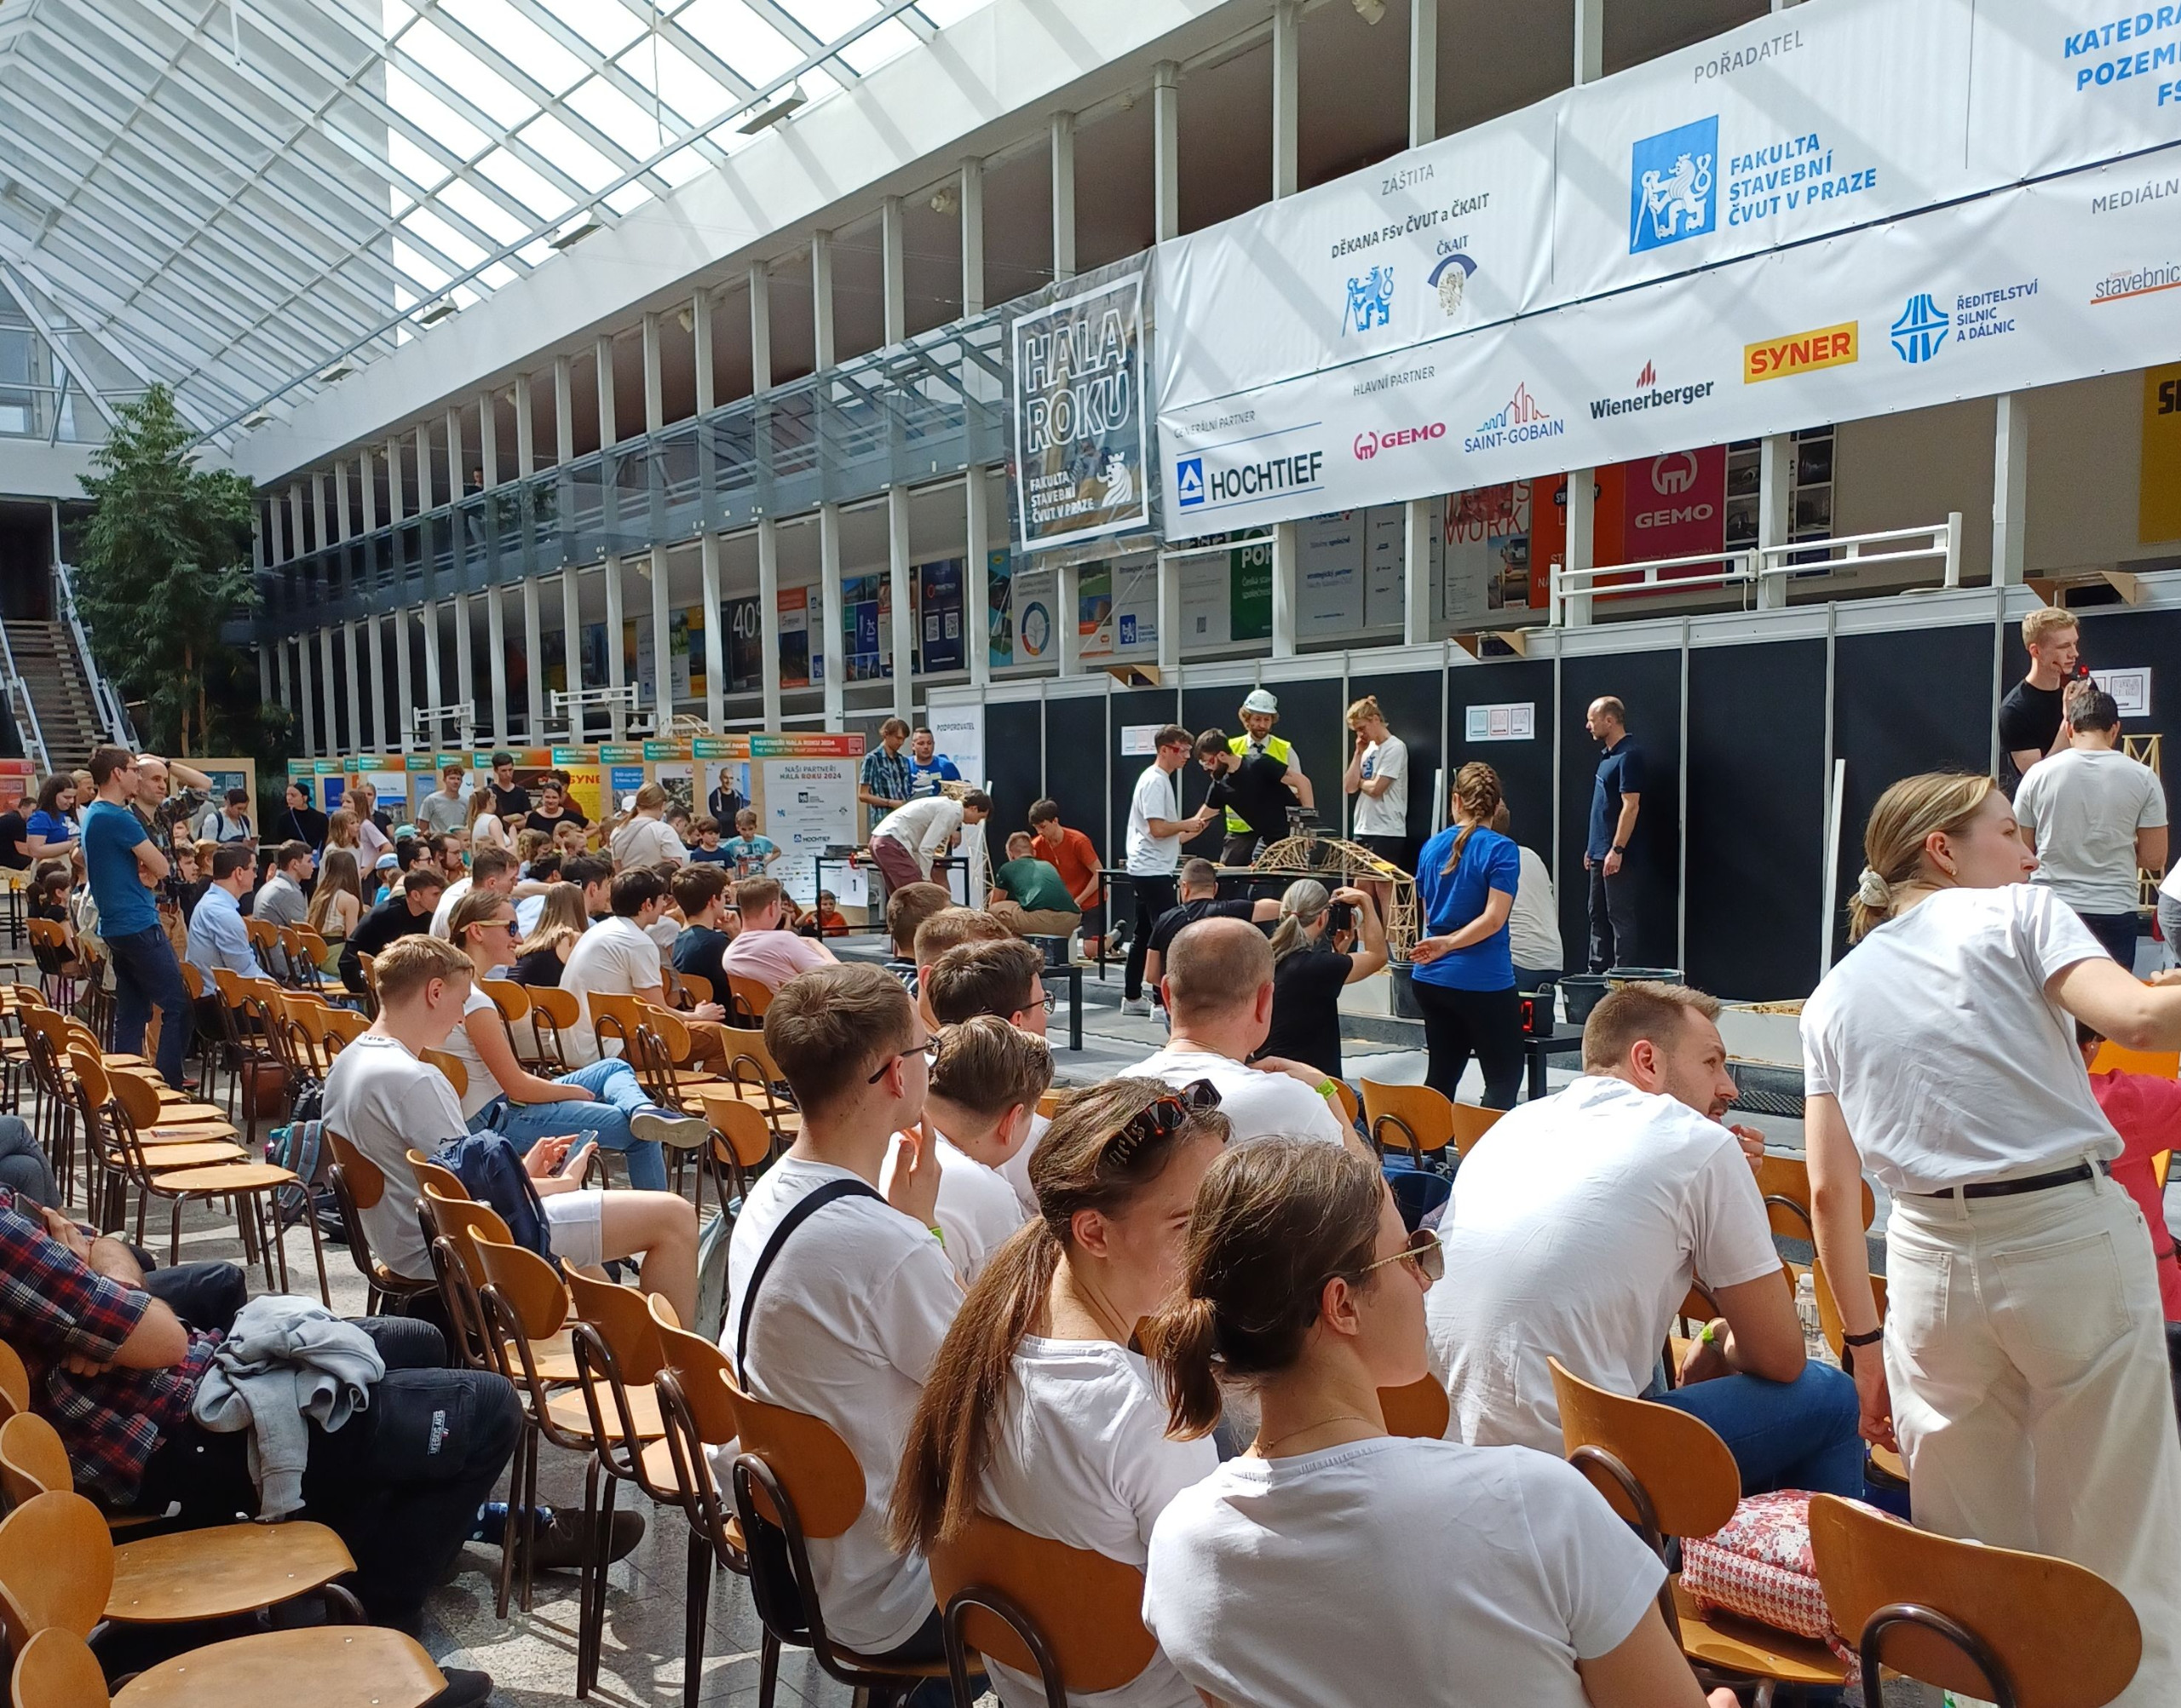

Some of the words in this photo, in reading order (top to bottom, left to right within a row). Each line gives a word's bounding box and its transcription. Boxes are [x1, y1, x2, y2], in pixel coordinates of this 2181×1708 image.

[1695, 30, 1804, 83] POŘADATEL
[2077, 41, 2181, 91] POZEM
[1730, 133, 1820, 176] FAKULTA
[1381, 164, 1435, 196] ZÁŠTITA
[1729, 148, 1833, 202] STAVEBNÍ
[1729, 196, 1781, 227] ČVUT
[1787, 190, 1800, 210] V
[1807, 168, 1877, 204] PRAZE
[1332, 231, 1379, 259] DĚKANA
[1382, 224, 1404, 241] FSv
[1406, 210, 1439, 233] ČVUT
[1442, 210, 1448, 222] a
[1451, 193, 1490, 218] ČKAIT
[1436, 234, 1470, 256] ČKAIT
[1957, 278, 2038, 311] ŘEDITELSTVÍ
[2096, 261, 2181, 298] stavebnic
[1956, 330, 1965, 342] A
[1969, 319, 2016, 340] DÁLNIC
[1957, 306, 1998, 326] SILNIC
[1025, 308, 1127, 394] HALA
[1751, 331, 1850, 375] SYNER
[1353, 373, 1389, 397] HLAVNÍ
[1390, 365, 1436, 388] PARTNER
[1026, 369, 1131, 454] ROKU
[1590, 380, 1714, 419] Wienerberger
[1218, 410, 1256, 429] PARTNER
[1381, 422, 1447, 449] GEMO
[1465, 418, 1564, 453] SAINT-GOBAIN
[1029, 470, 1070, 492] FAKULTA
[1211, 451, 1323, 502] HOCHTIEF
[1031, 480, 1076, 508] STAVEBNÍ
[1032, 507, 1056, 524] ČVUT
[1056, 504, 1064, 518] V
[1065, 497, 1095, 517] PRAZE
[1634, 503, 1714, 529] GEMO
[803, 764, 837, 773] PARTNEŘI
